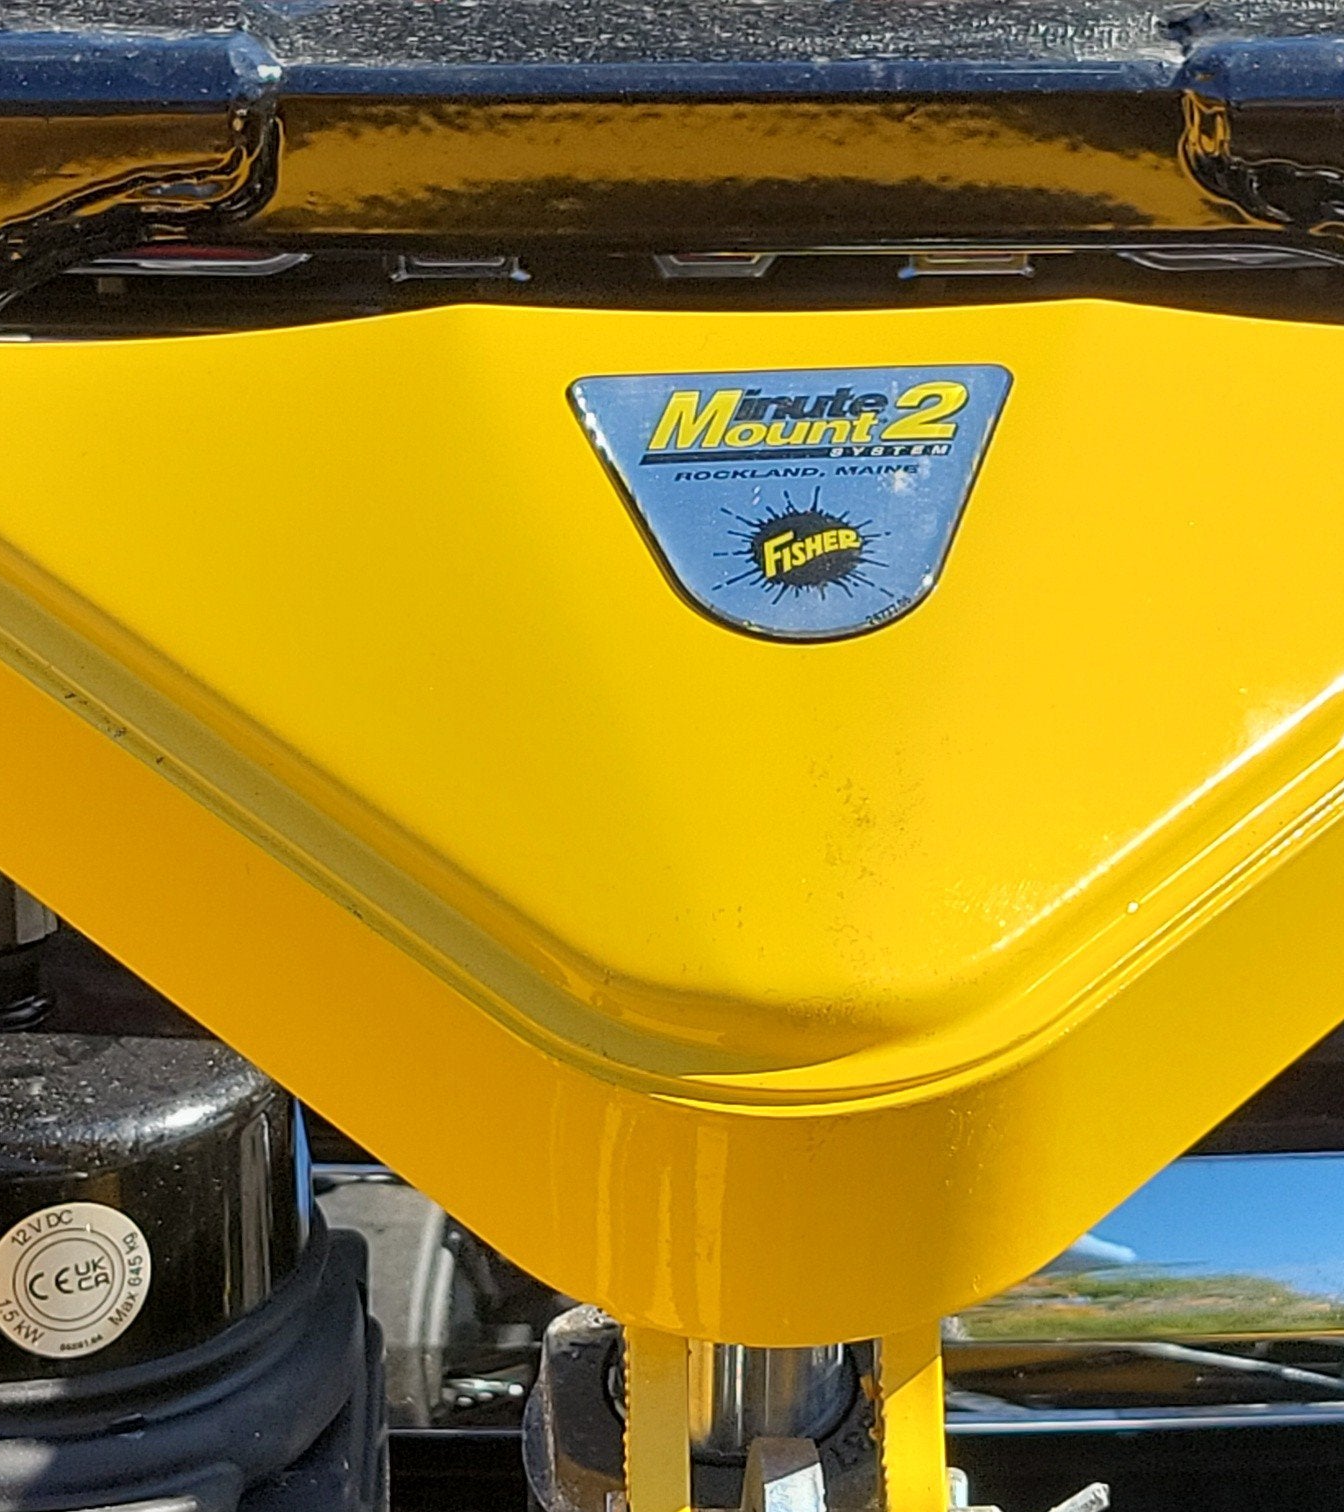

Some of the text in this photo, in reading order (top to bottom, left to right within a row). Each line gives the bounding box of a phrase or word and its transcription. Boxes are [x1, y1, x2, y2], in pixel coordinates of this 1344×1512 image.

[881, 381, 970, 442] 2
[828, 444, 951, 459] SYSTEM
[674, 463, 920, 482] ROCKLAND, MAINE
[762, 528, 864, 580] FISHER
[74, 1255, 105, 1277] UK
[77, 1272, 111, 1292] CA
[107, 1291, 141, 1327] Max
[13, 1319, 46, 1345] kW
